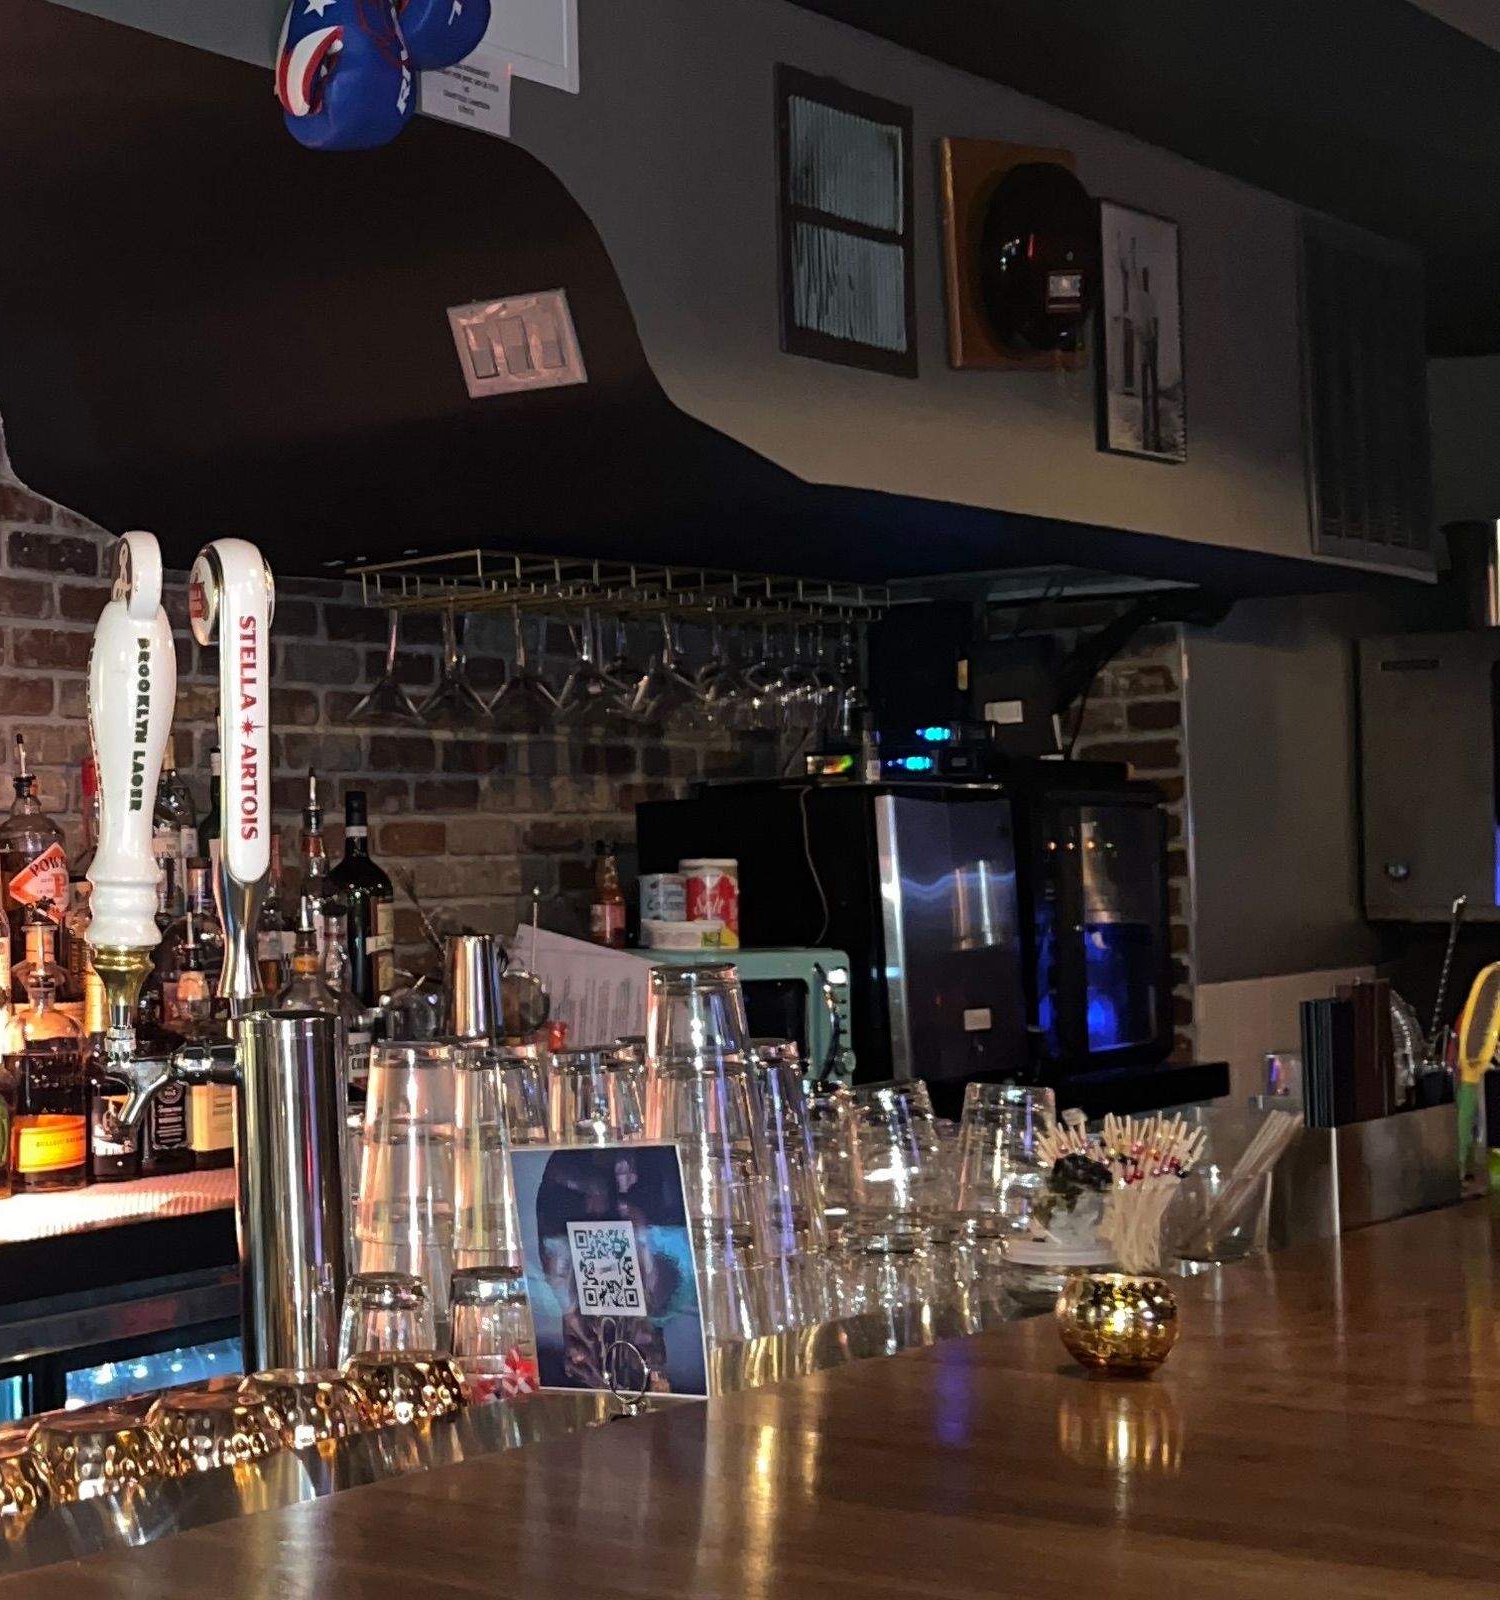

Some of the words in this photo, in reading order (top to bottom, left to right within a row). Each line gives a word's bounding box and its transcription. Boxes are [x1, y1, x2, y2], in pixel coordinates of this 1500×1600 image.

[135, 637, 151, 743] BROOKLYN
[238, 615, 257, 711] STELLA
[240, 743, 259, 841] ARTOIS
